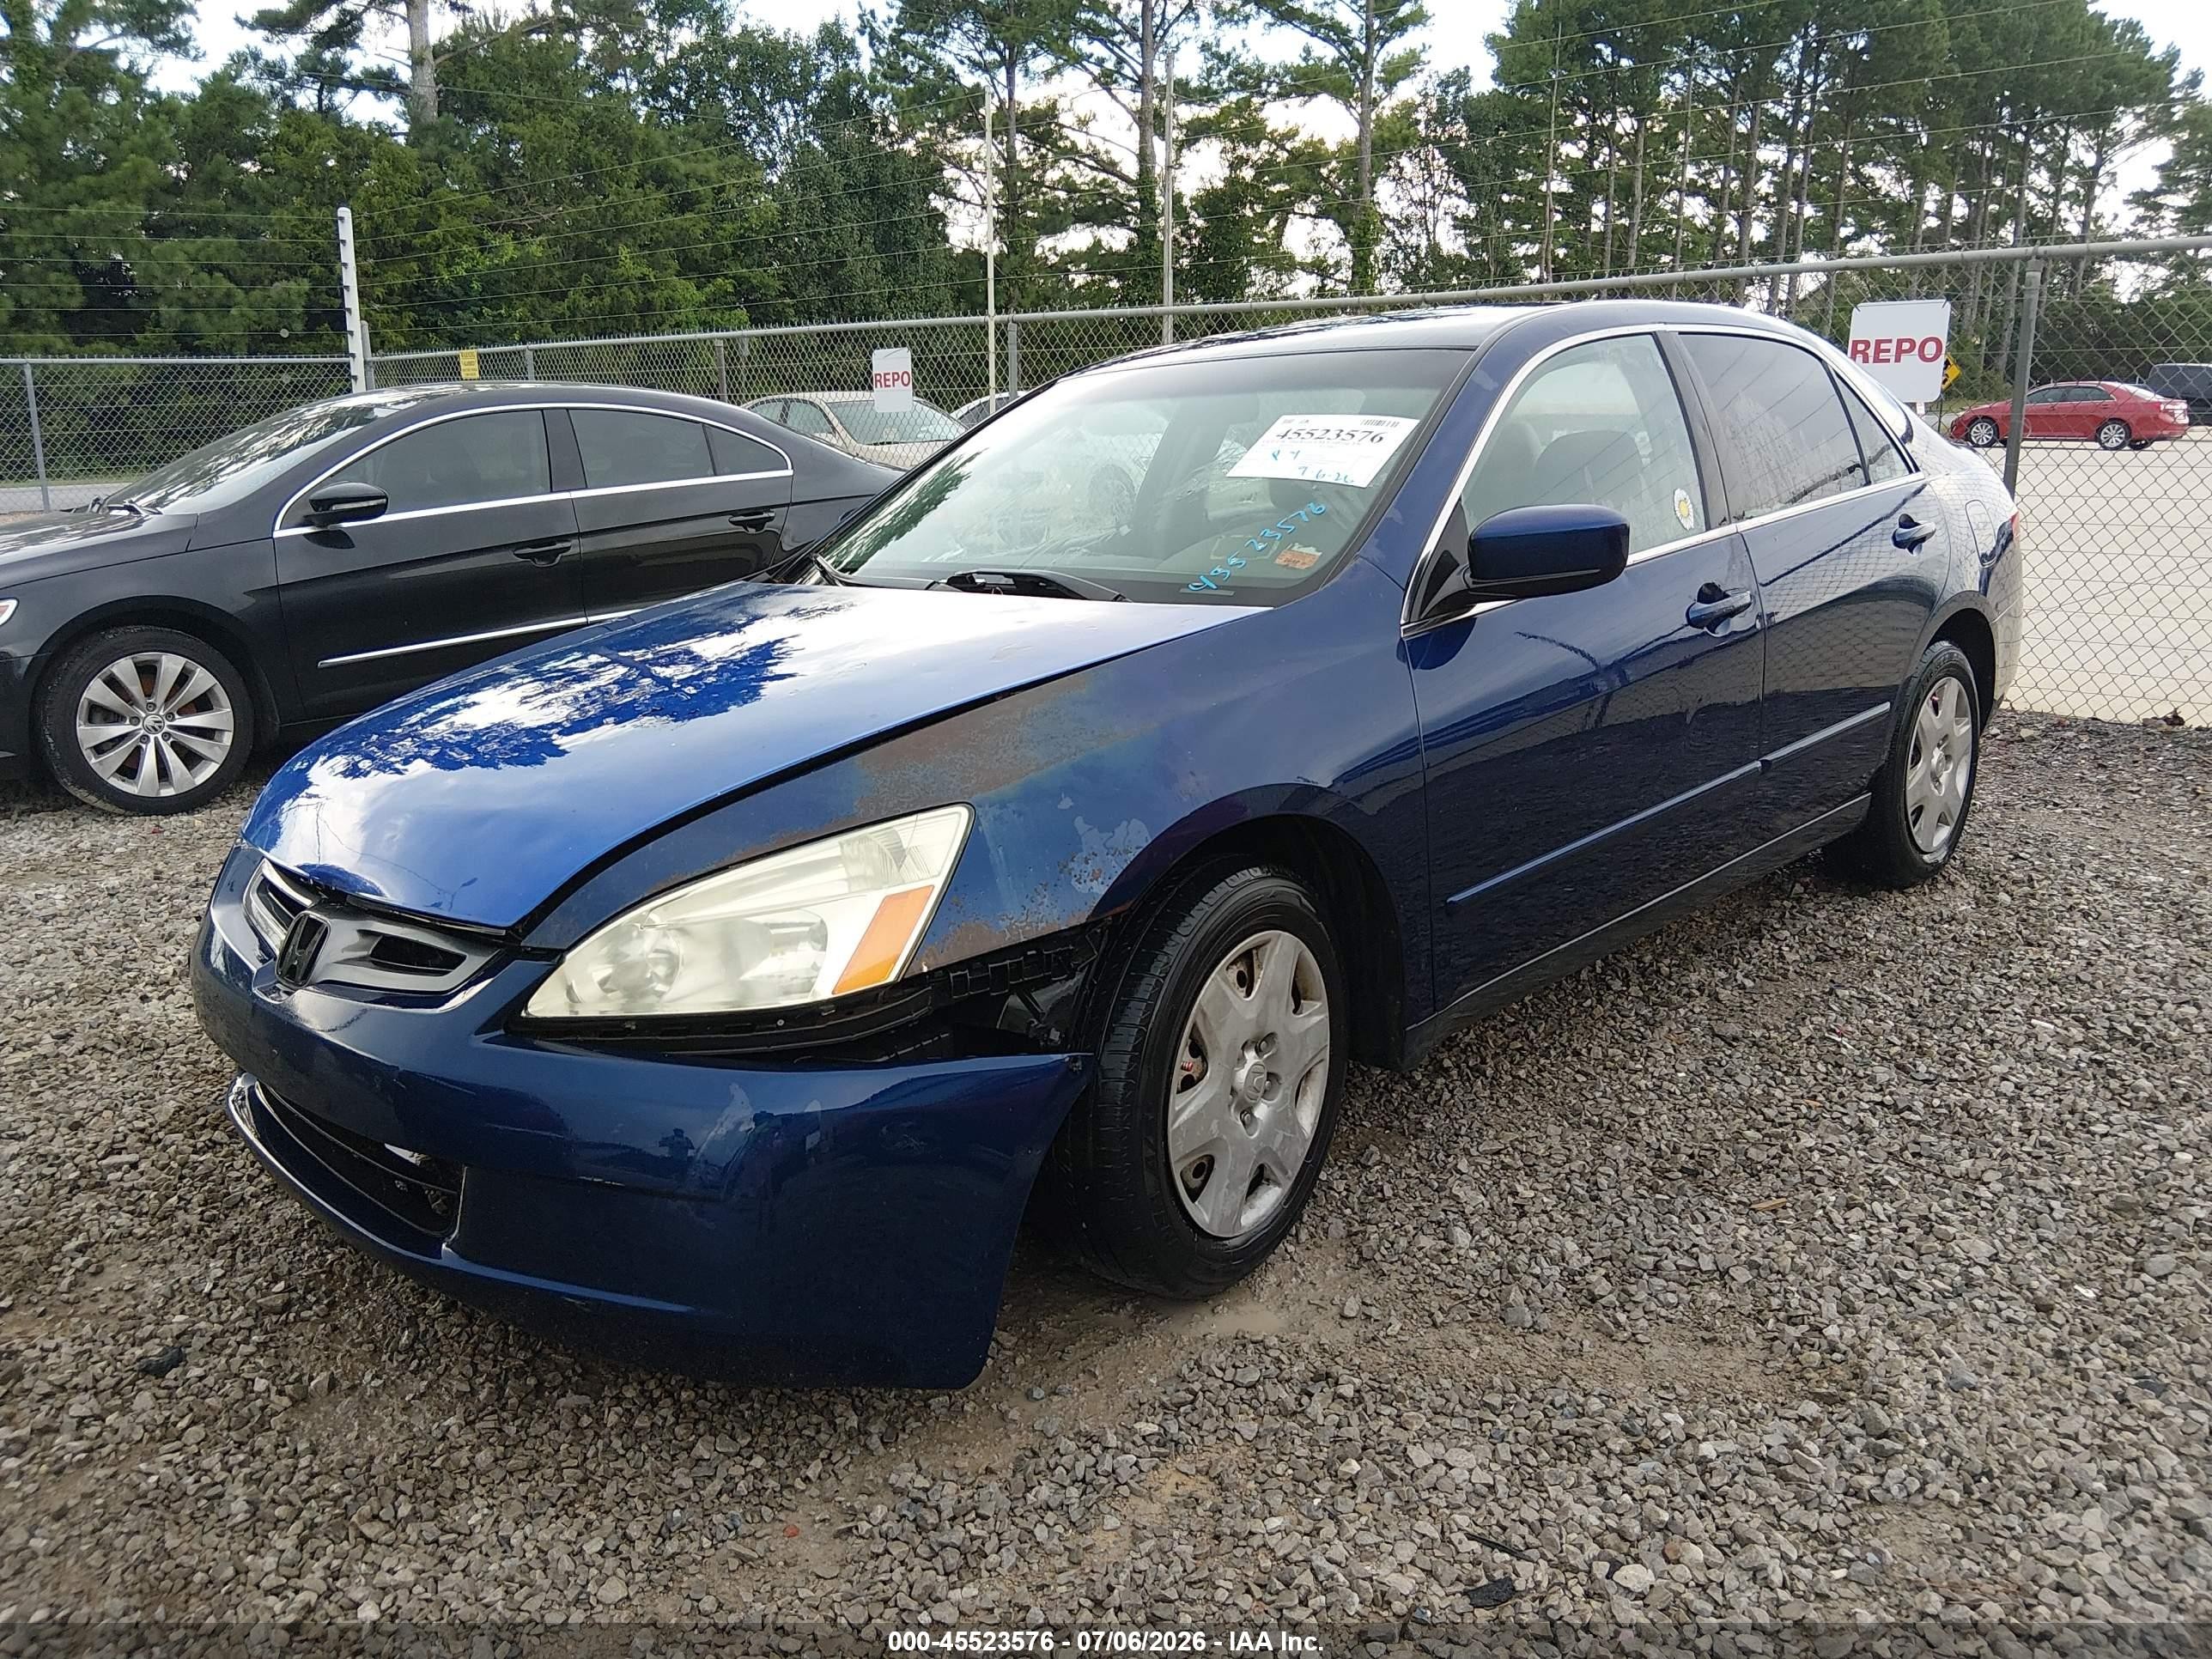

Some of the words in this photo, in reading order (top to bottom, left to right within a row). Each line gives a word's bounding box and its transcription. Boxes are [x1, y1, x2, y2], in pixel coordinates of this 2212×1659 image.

[1850, 337, 1943, 364] REPO
[874, 371, 911, 388] REPO
[1276, 428, 1388, 444] 45523576
